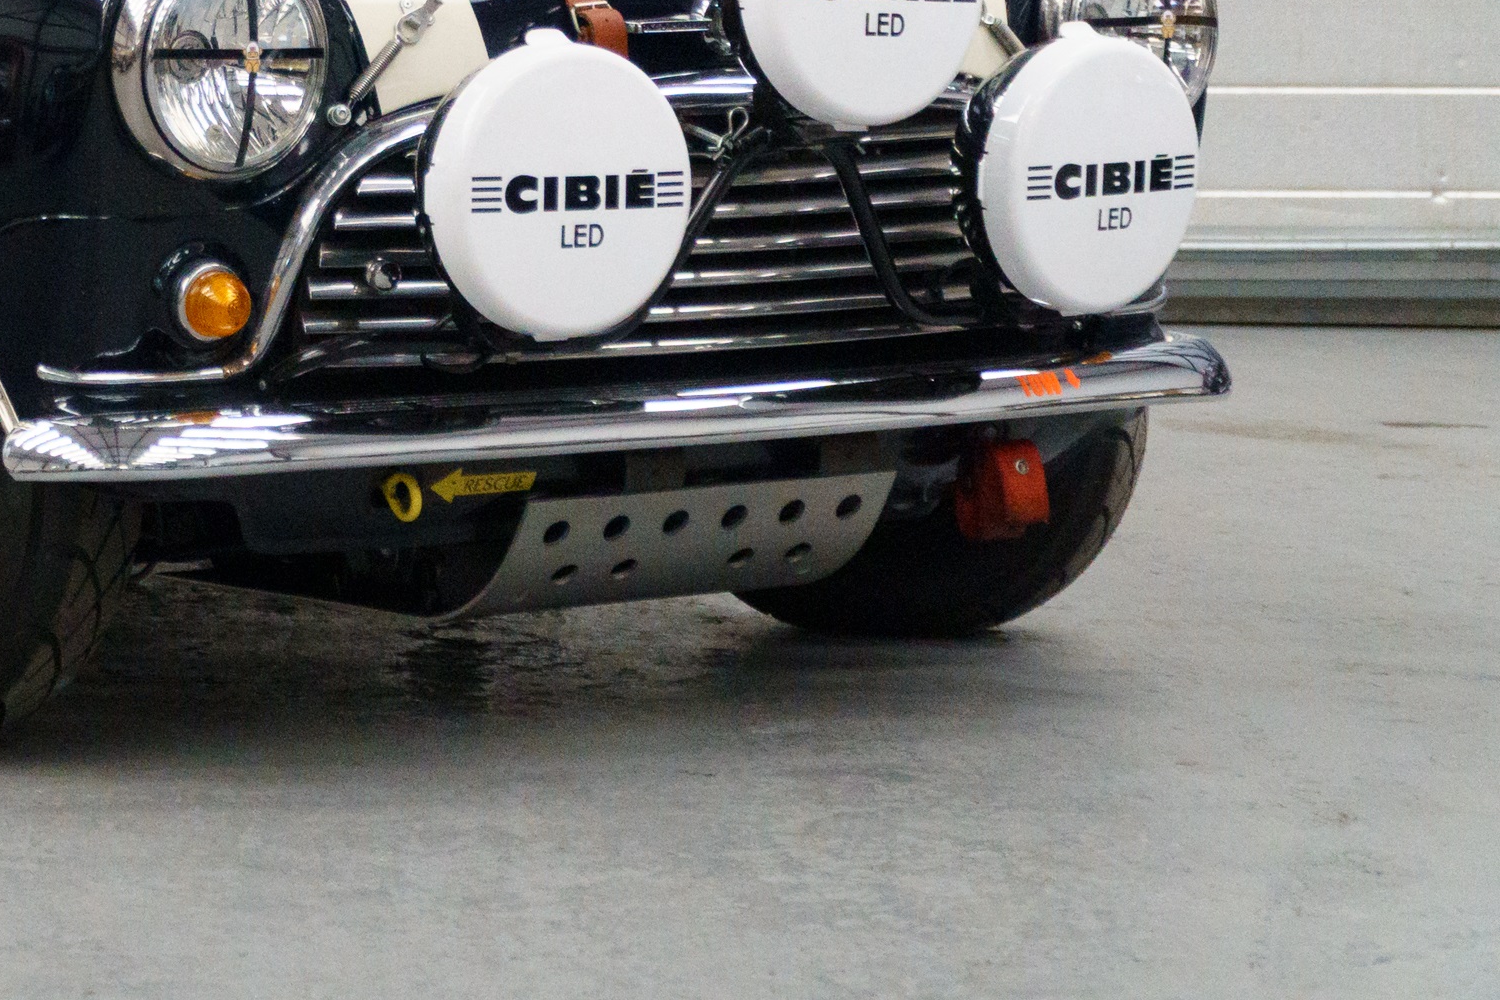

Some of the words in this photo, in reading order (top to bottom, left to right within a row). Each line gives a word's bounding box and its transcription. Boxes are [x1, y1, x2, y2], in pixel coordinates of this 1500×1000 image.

[864, 12, 906, 37] LED
[1097, 206, 1133, 232] LED
[560, 223, 605, 250] LED
[1014, 370, 1063, 398] TOW
[463, 474, 528, 492] RESCUE
